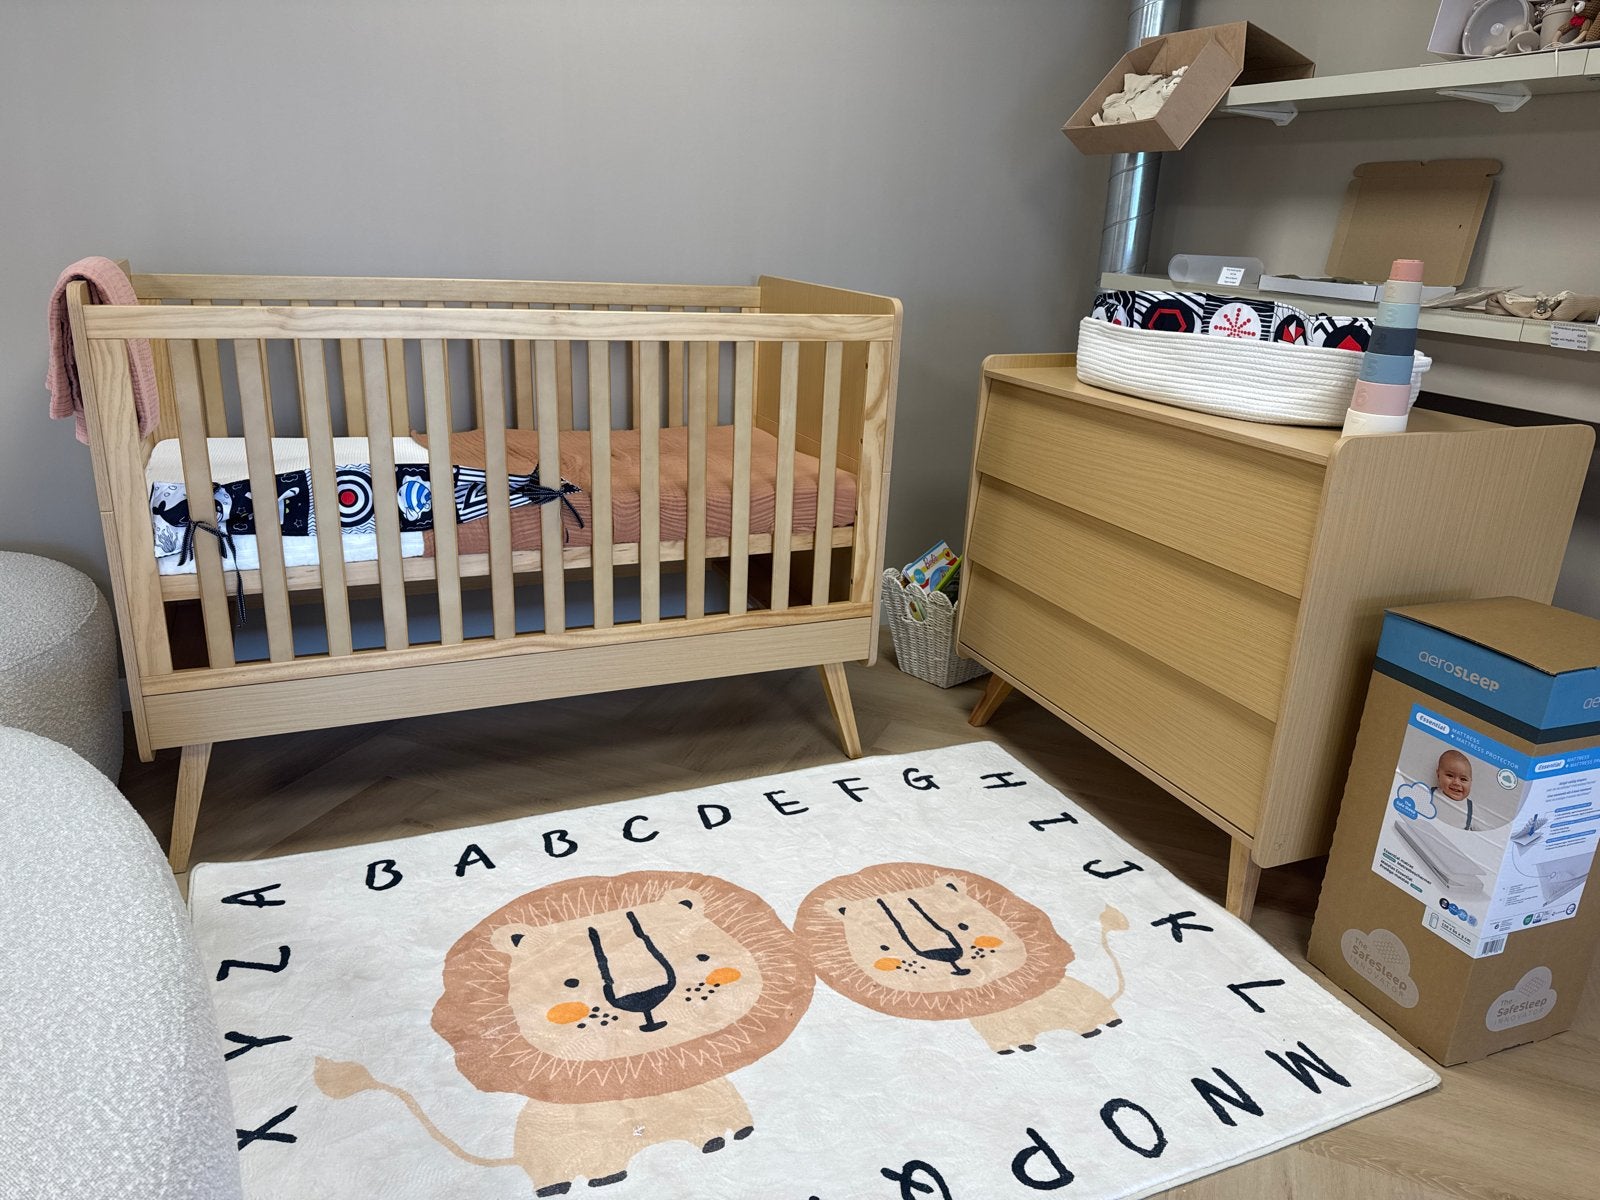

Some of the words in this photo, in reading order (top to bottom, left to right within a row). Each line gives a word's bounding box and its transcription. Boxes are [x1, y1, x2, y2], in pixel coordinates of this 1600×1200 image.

[1419, 715, 1447, 732] Essential
[1451, 728, 1480, 745] MATTRESS
[1456, 736, 1485, 754] MATTRESS
[1485, 750, 1519, 770] PROTECTOR
[366, 860, 403, 891] B
[454, 844, 496, 877] A
[542, 830, 578, 858] B
[622, 816, 659, 842] C
[698, 804, 732, 829] D
[763, 790, 809, 816] E
[833, 778, 869, 802] F
[903, 768, 940, 790] G
[980, 772, 1027, 790] H
[221, 883, 285, 908] A
[1083, 859, 1144, 879] J
[1151, 911, 1214, 943] K
[1227, 979, 1285, 1014] L
[1355, 937, 1368, 949] The
[216, 945, 291, 981] Z
[1350, 954, 1405, 998] INNOVATOR
[1352, 945, 1408, 991] SafeSleep
[1496, 998, 1548, 1017] SafeSleep
[1500, 999, 1513, 1007] The
[224, 1031, 293, 1061] Y
[1265, 1041, 1351, 1094] M
[1191, 1068, 1264, 1126] N
[236, 1105, 298, 1151] X
[1099, 1098, 1168, 1158] O
[1012, 1128, 1075, 1191] P
